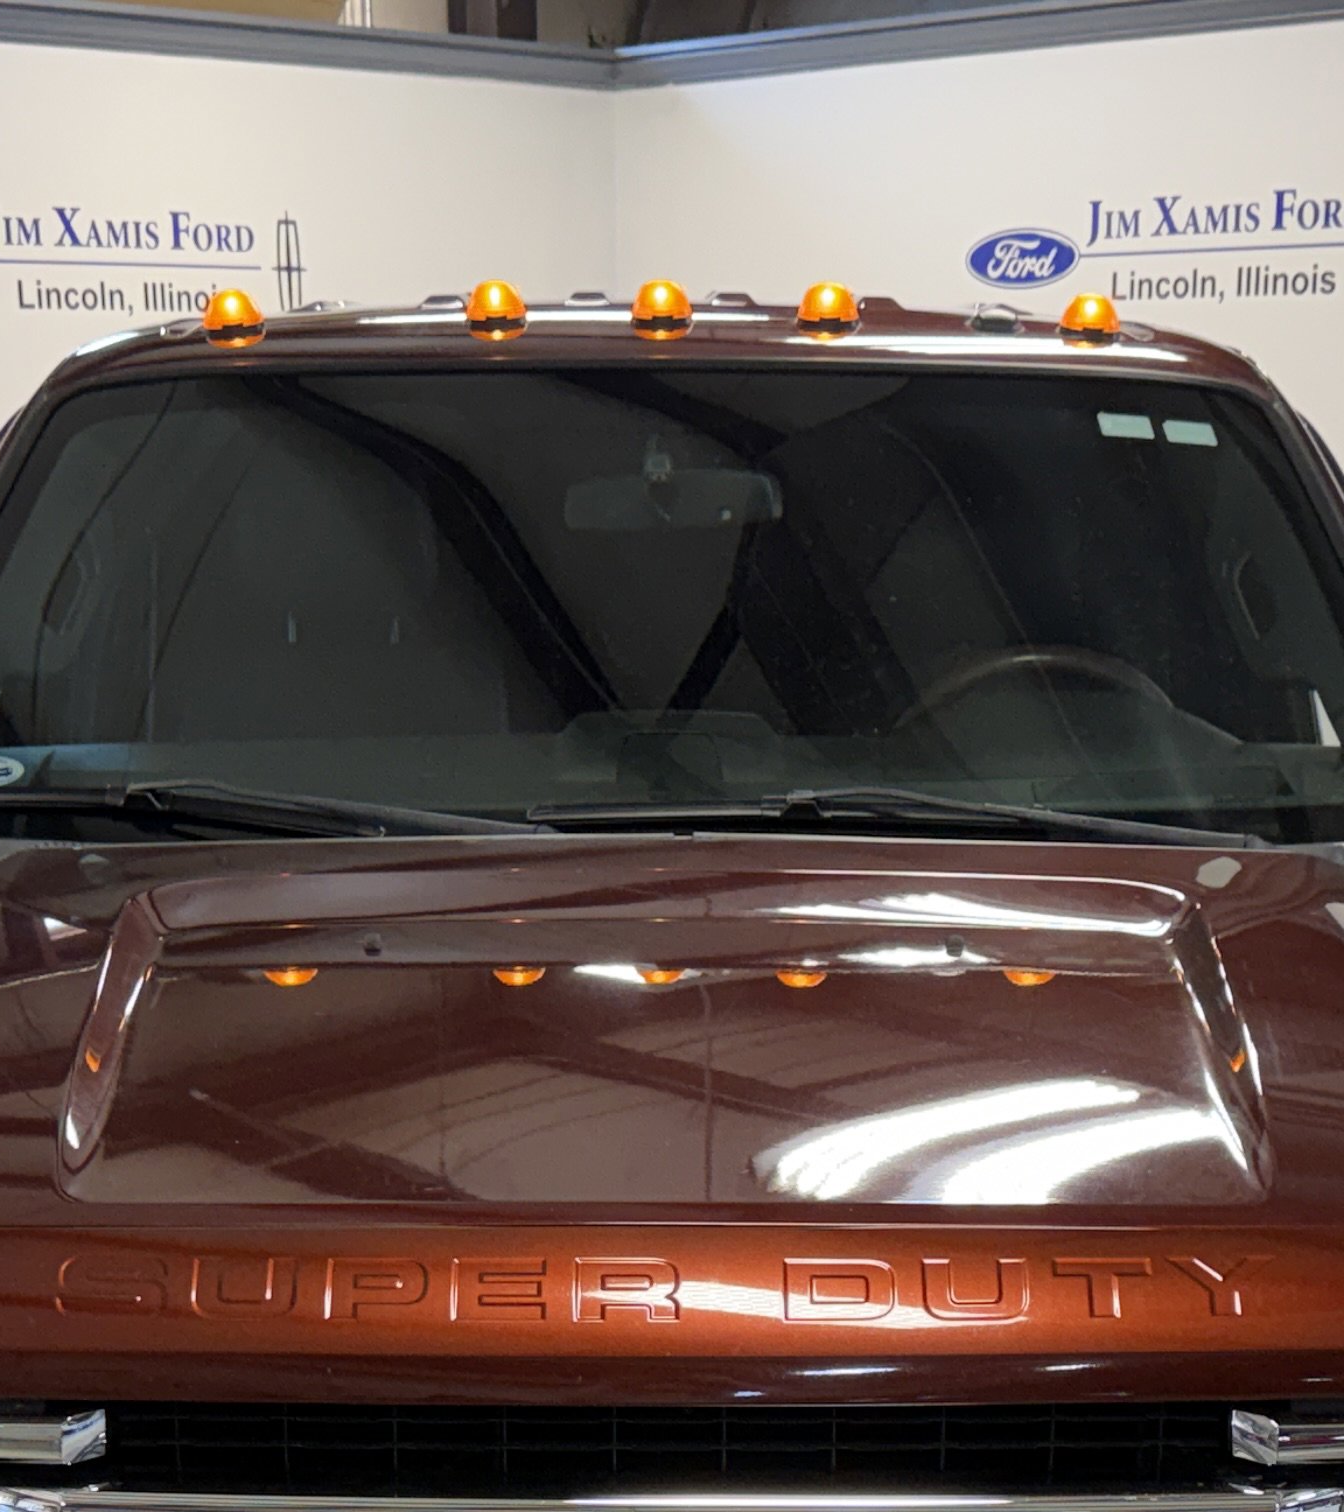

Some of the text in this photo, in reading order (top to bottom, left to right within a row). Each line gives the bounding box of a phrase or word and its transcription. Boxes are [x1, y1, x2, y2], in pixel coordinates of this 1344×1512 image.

[53, 207, 160, 249] XAMIS
[169, 211, 255, 253] FORD
[1087, 200, 1141, 247] JIM
[1152, 196, 1260, 237] XAMIS
[987, 238, 1056, 280] Ford
[17, 279, 217, 317] Lincoln, Illino
[1111, 263, 1336, 304] Lincoln, Illinois
[56, 1256, 1276, 1323] SUPER DUTY
